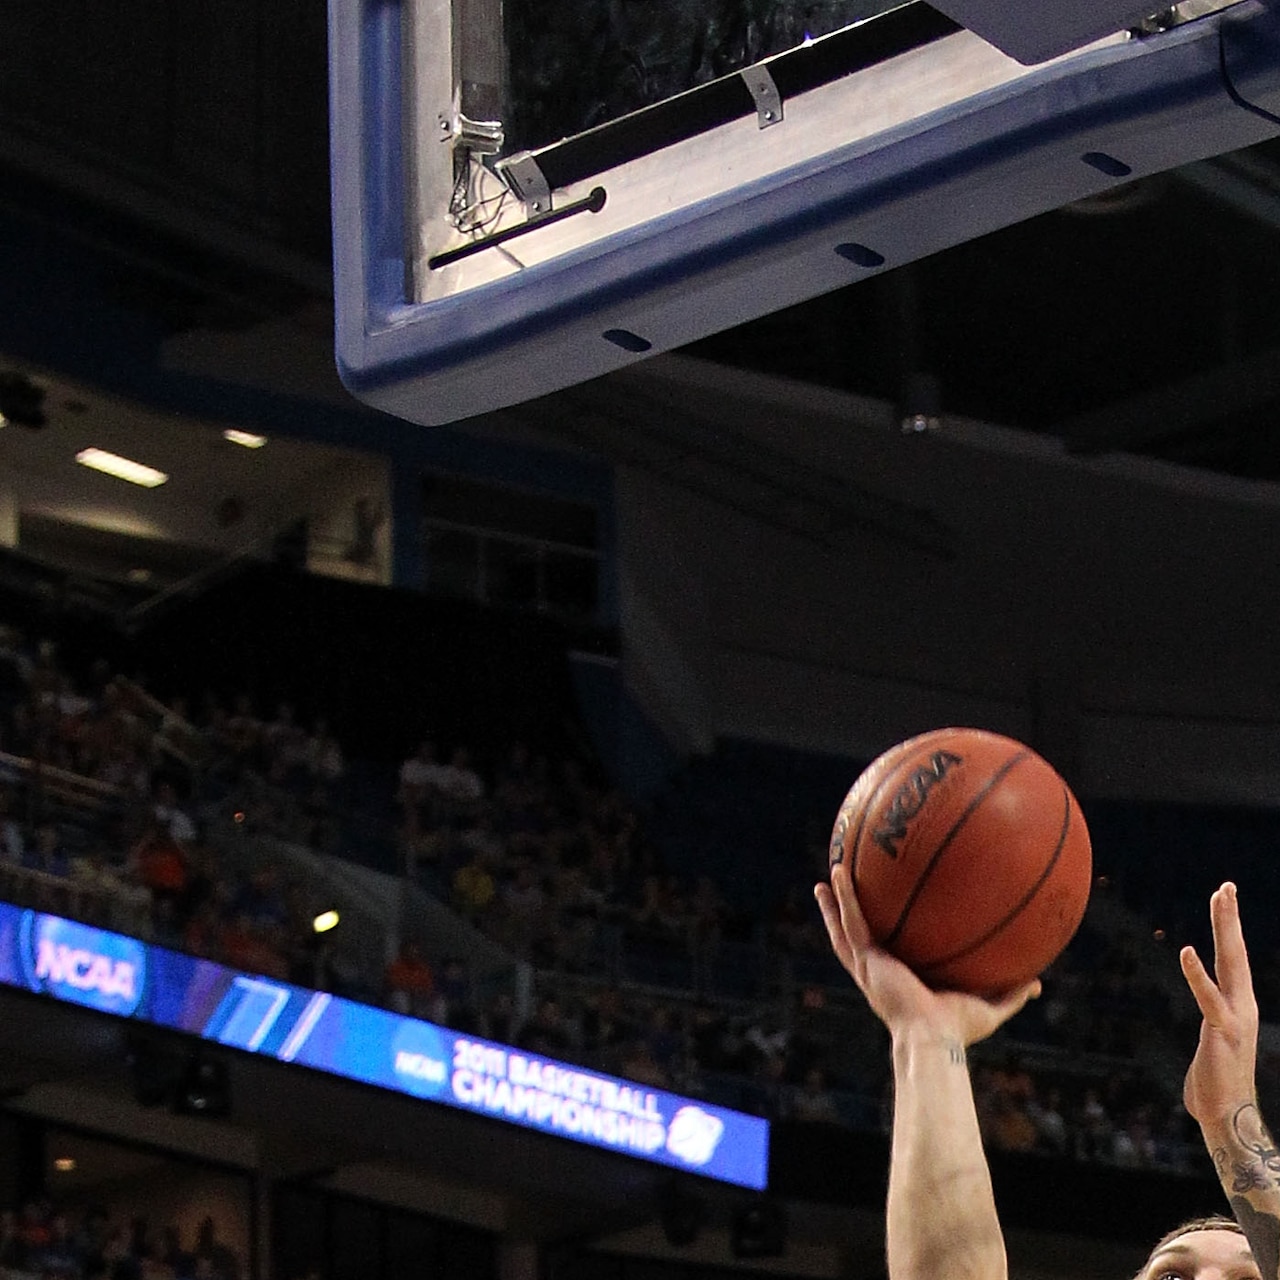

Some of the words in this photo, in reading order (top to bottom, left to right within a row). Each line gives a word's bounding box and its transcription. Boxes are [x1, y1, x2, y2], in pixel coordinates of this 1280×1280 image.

[873, 749, 964, 859] NCAA
[35, 938, 136, 999] NCAA
[452, 1068, 666, 1152] CHAMPIONSHIP
[453, 1039, 507, 1078] 2011
[508, 1054, 664, 1124] BASKETBALL
